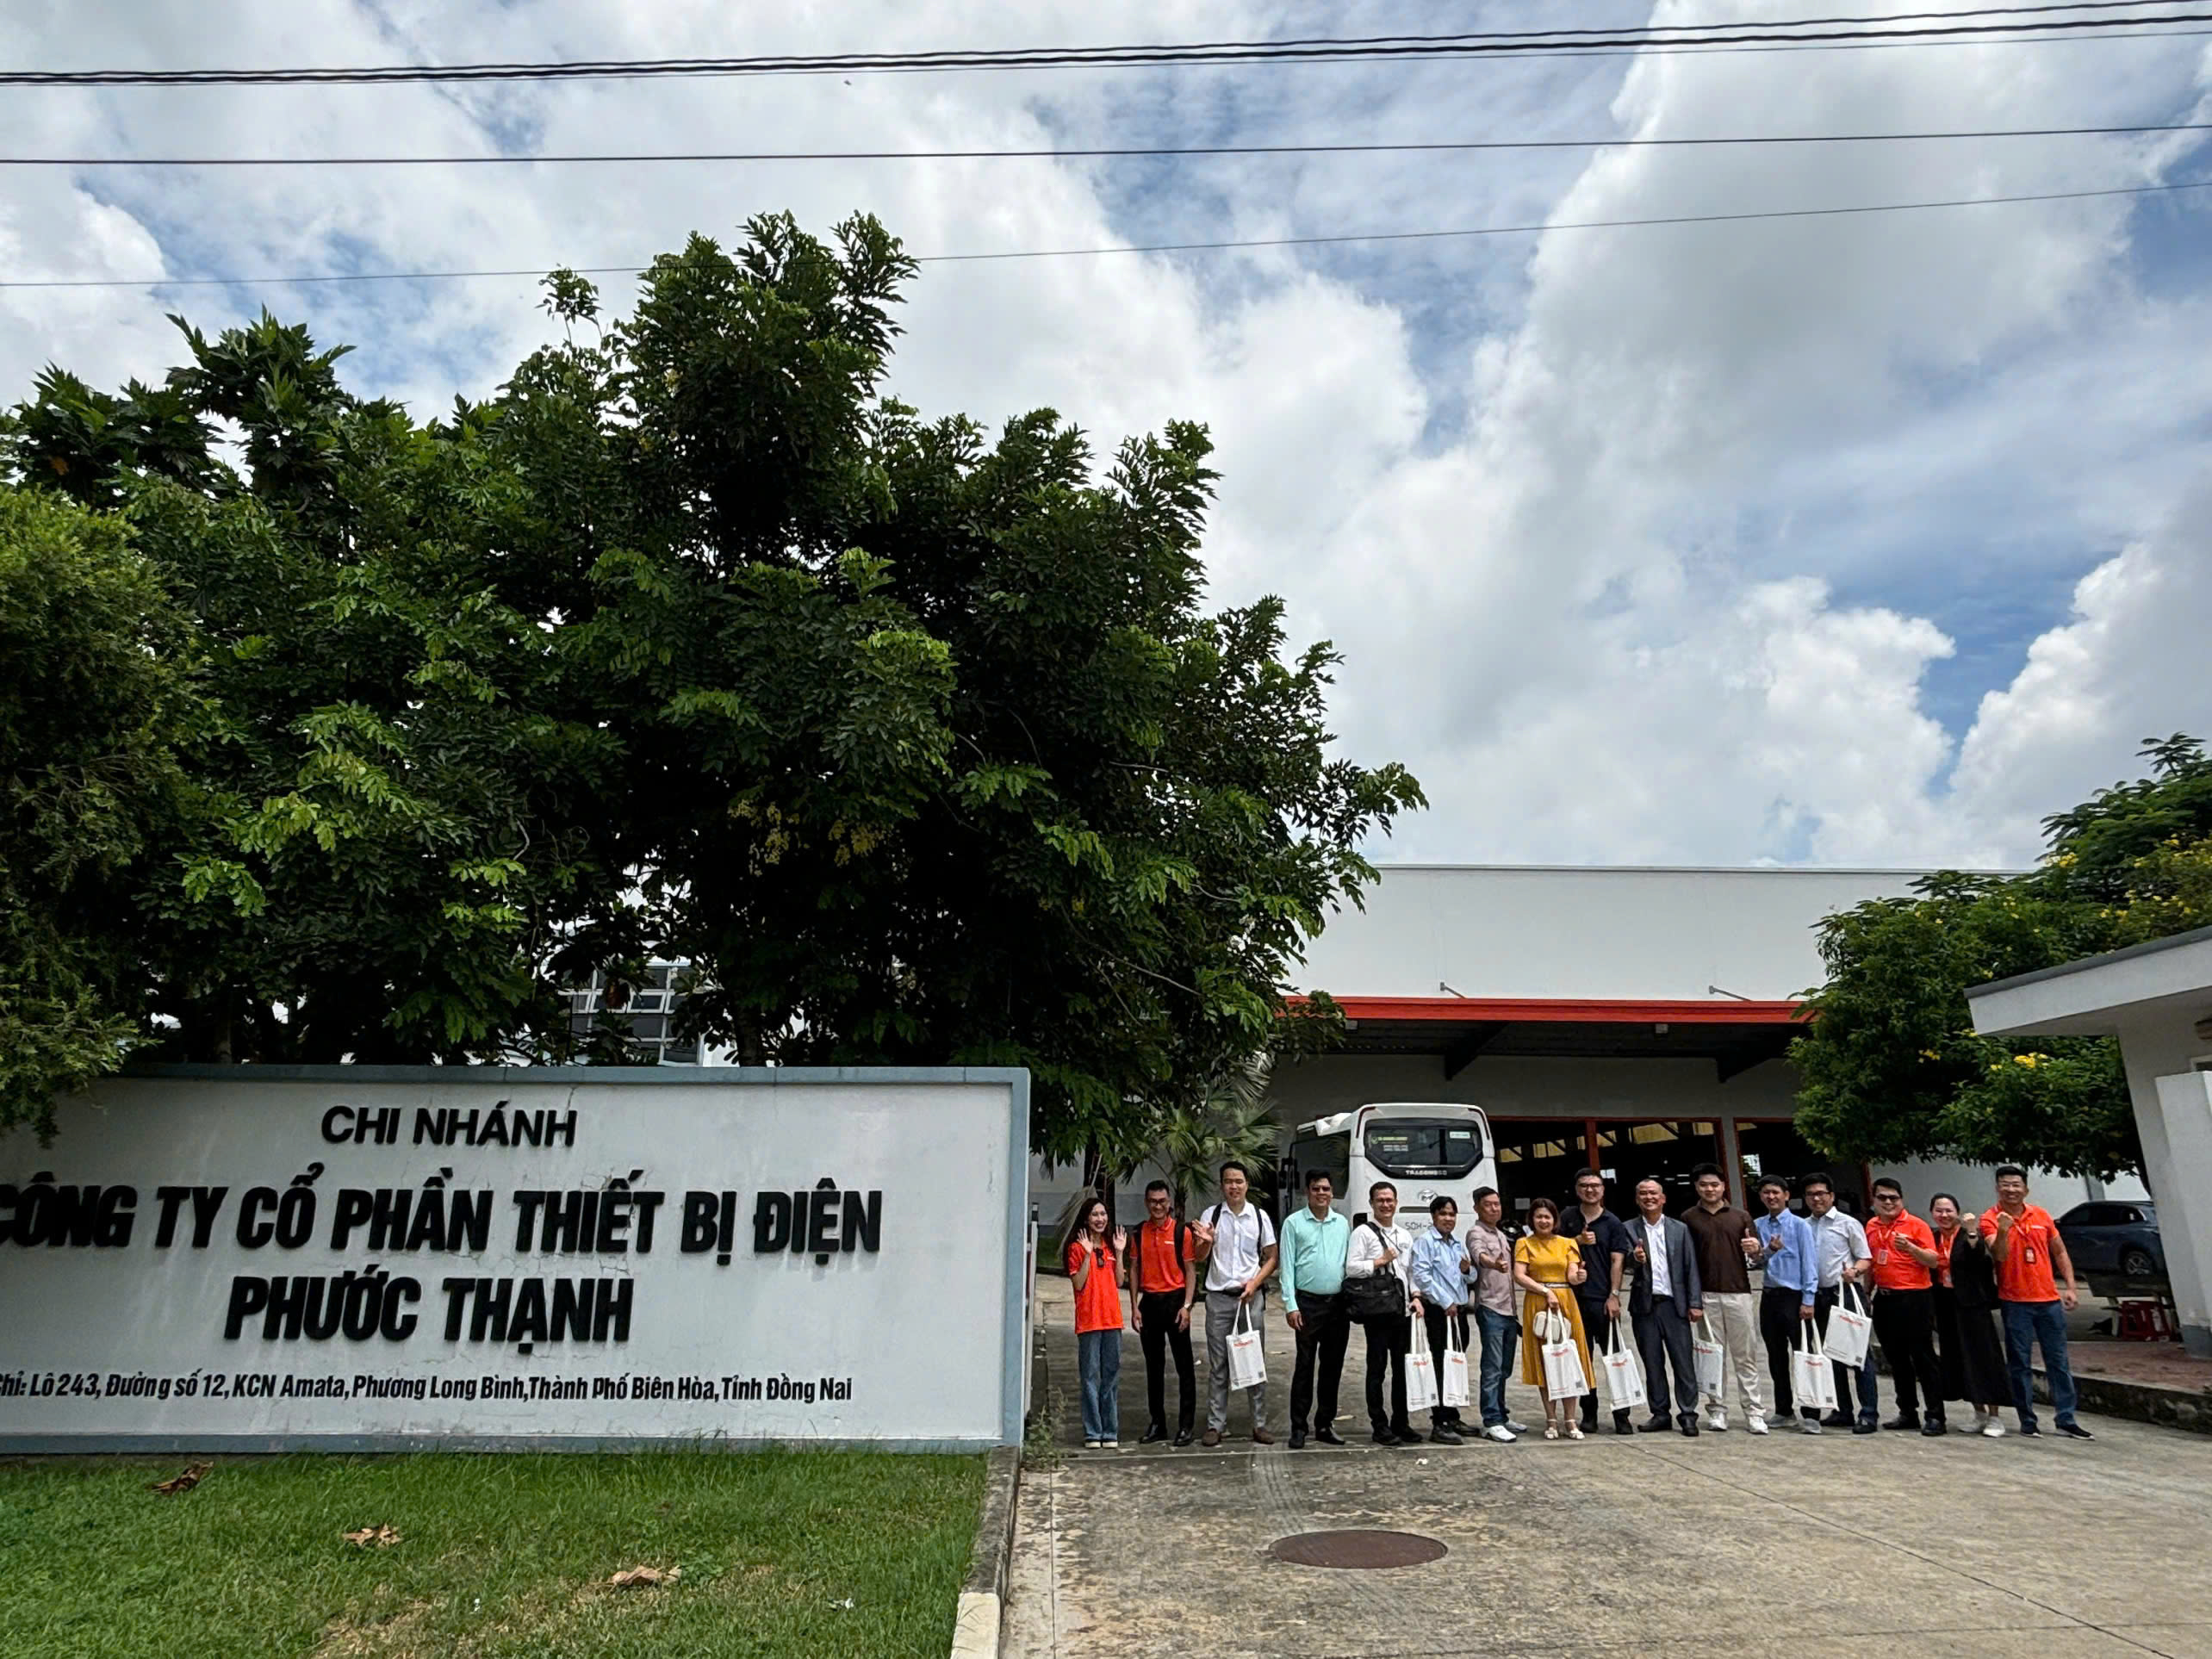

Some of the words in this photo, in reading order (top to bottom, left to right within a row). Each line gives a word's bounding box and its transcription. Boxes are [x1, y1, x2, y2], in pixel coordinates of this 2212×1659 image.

[321, 1106, 401, 1145] CHI
[413, 1101, 578, 1147] NHÁNH
[155, 1186, 229, 1249] TY
[236, 1162, 325, 1250] CỔ
[331, 1167, 494, 1252] PHẦN
[513, 1170, 666, 1253] THIẾT
[680, 1190, 737, 1266] BỊ
[753, 1177, 883, 1266] ĐIỆN
[223, 1264, 422, 1342] PHƯỚC
[442, 1277, 635, 1355] THẠNH
[0, 1370, 28, 1397] hỉ:
[174, 1368, 203, 1397] số
[232, 1374, 277, 1398] KCN
[430, 1375, 478, 1401] Long
[591, 1372, 631, 1400] Phố
[631, 1376, 674, 1400] Biên
[766, 1372, 816, 1404] Đồng
[819, 1376, 852, 1401] Nai
